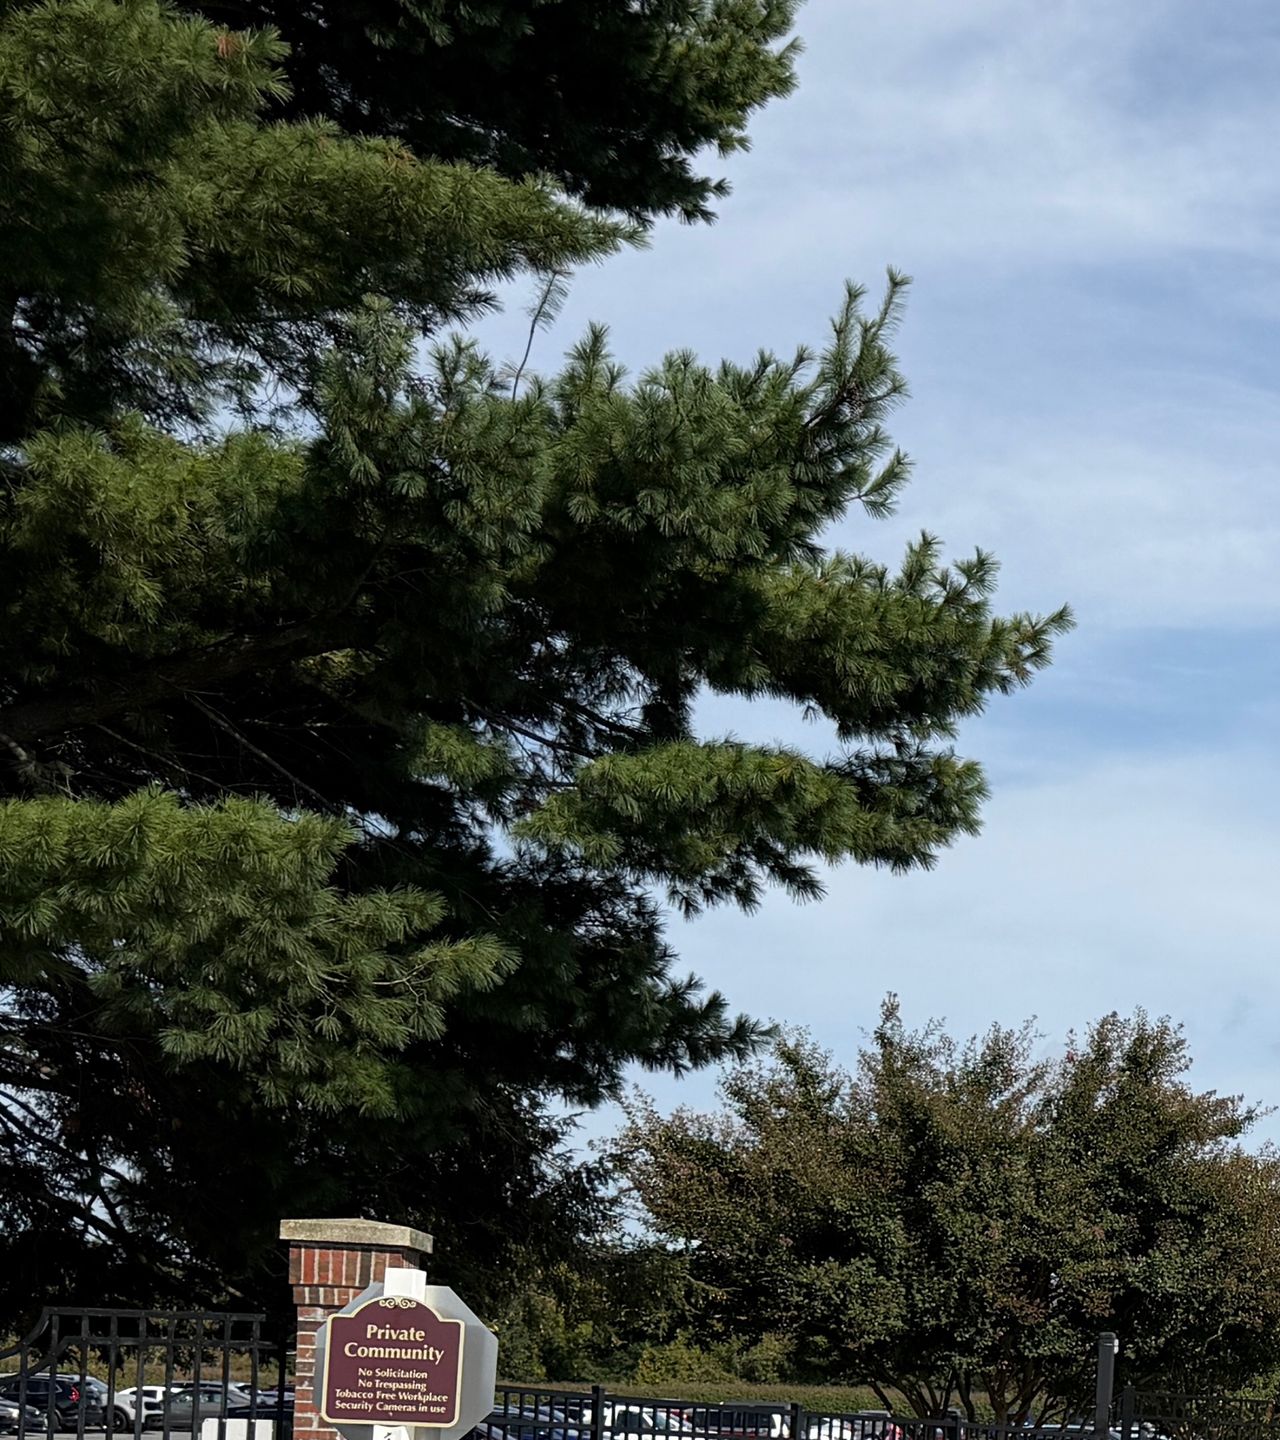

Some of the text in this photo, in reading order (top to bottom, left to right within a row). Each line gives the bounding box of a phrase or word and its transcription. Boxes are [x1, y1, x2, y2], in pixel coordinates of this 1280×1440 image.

[366, 1324, 426, 1341] Private
[344, 1342, 445, 1365] Community
[358, 1368, 428, 1379] No Solicitation
[358, 1379, 427, 1392] No Trespassing
[335, 1389, 448, 1404] Tobacco Free Workplace
[335, 1400, 374, 1412] Security
[376, 1402, 417, 1412] Cameras
[418, 1403, 428, 1412] in
